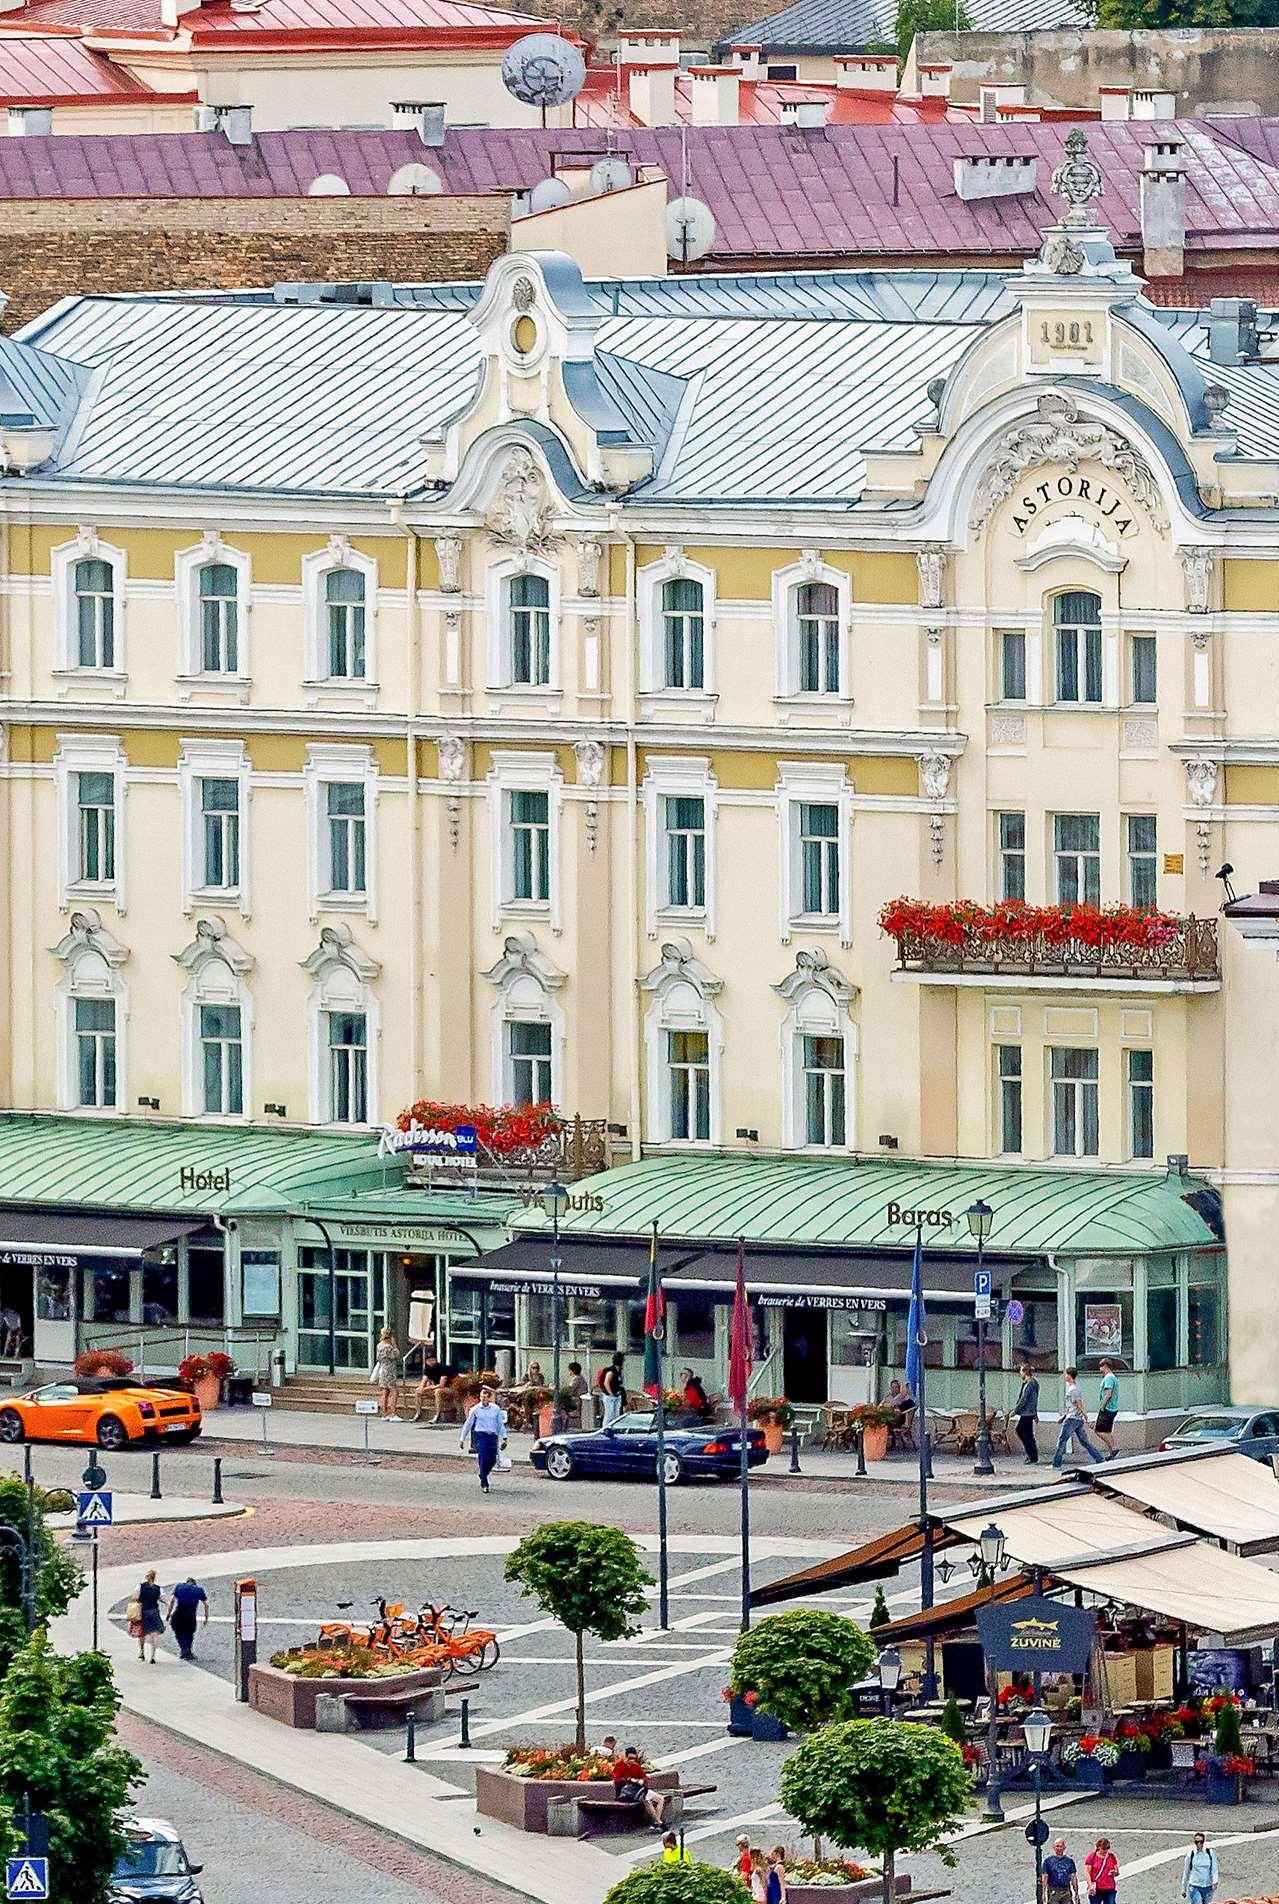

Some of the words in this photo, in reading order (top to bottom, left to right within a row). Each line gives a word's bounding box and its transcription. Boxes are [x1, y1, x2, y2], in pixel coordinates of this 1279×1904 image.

[1040, 321, 1094, 343] 1901
[1012, 476, 1134, 535] ASTORIJA
[377, 1118, 457, 1159] Radisson
[457, 1135, 474, 1144] BLU
[181, 1167, 230, 1191] Hotel
[887, 1202, 952, 1226] Baras
[490, 1280, 521, 1292] brasserie
[521, 1282, 531, 1293] de
[578, 1286, 601, 1297] VERS
[979, 1275, 987, 1293] P
[758, 1294, 794, 1307] brasserie
[795, 1295, 805, 1307] de
[806, 1296, 844, 1309] VERRES
[845, 1299, 860, 1310] EN
[860, 1300, 887, 1310] VERS
